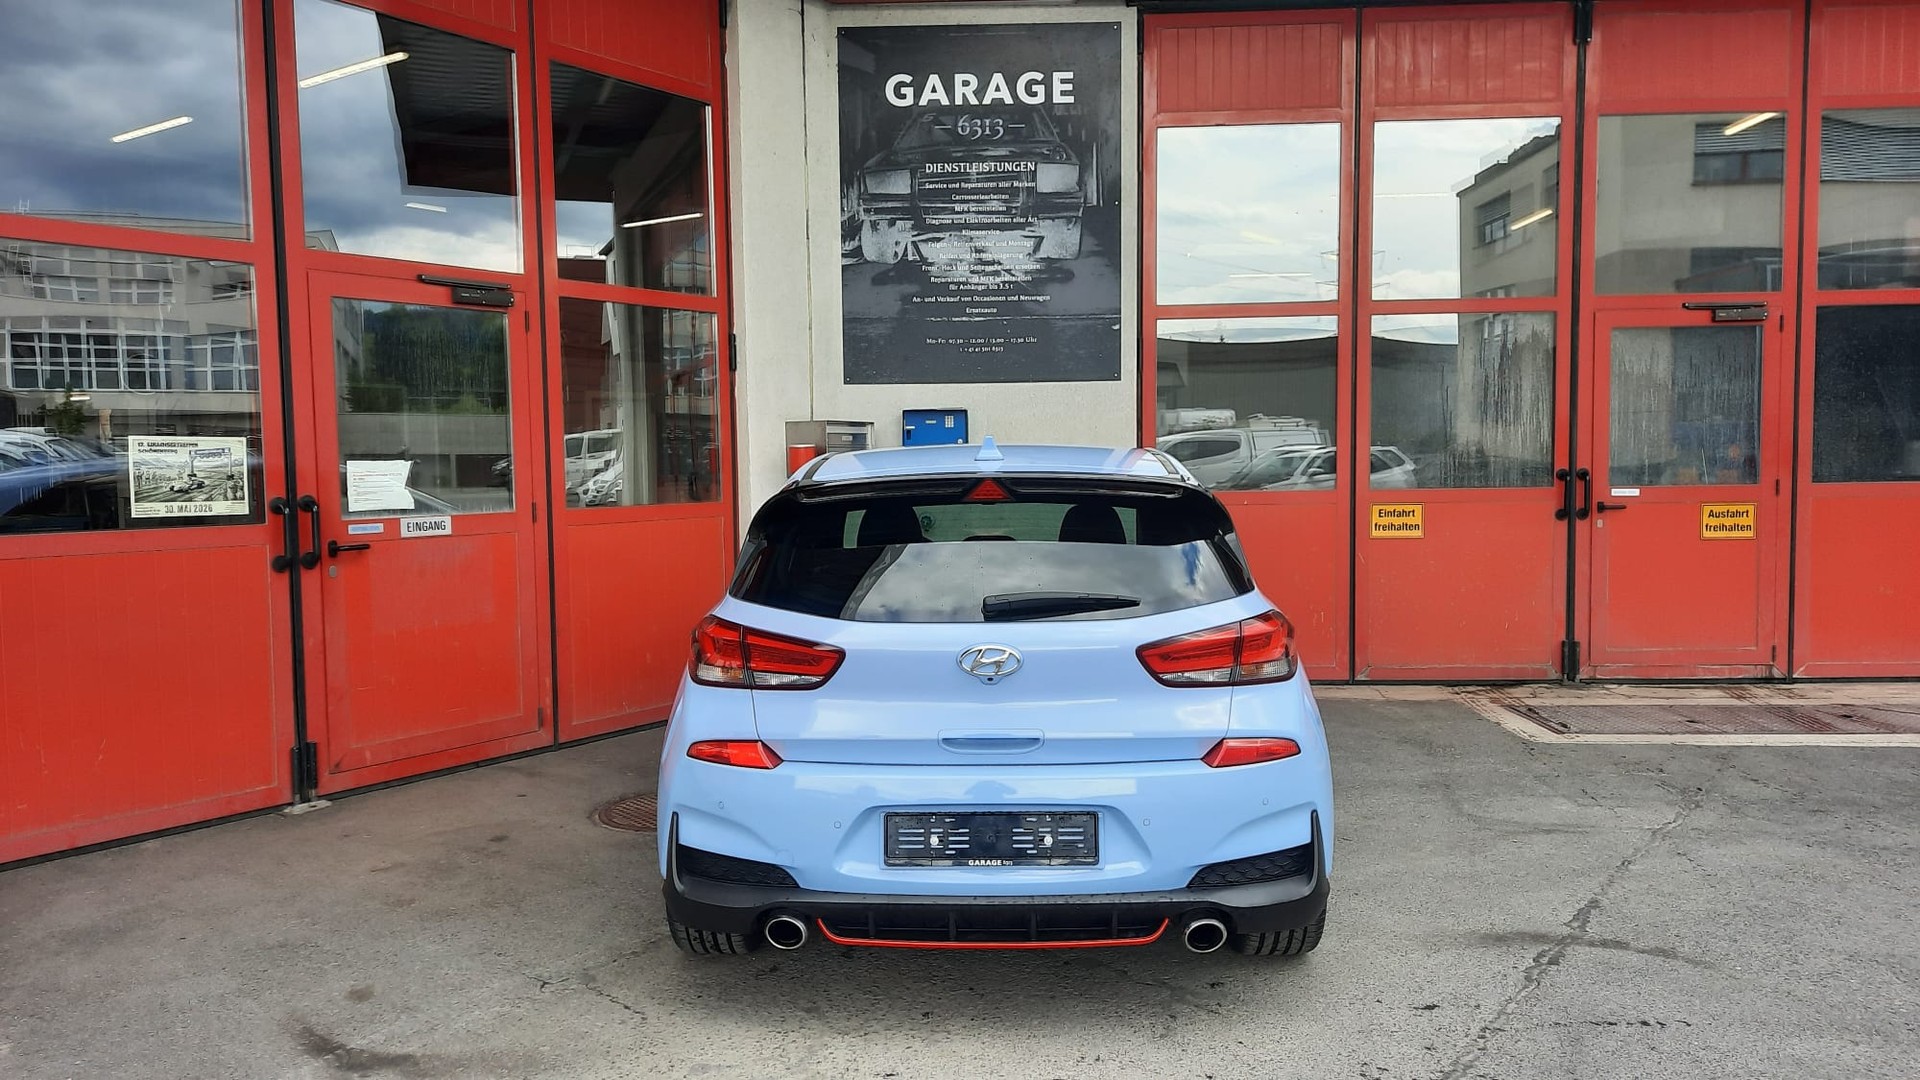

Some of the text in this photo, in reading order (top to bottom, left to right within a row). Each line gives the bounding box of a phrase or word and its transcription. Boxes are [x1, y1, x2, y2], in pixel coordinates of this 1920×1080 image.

[885, 72, 1075, 106] GARAGE
[957, 114, 1004, 139] 6313
[925, 162, 1036, 173] DIENSTLEISTUNGEN
[961, 182, 997, 190] Reparaturen
[177, 504, 192, 514] MAI
[194, 504, 213, 513] 2026
[1378, 508, 1415, 518] Einfahrt
[1708, 509, 1749, 518] Ausfahrt
[406, 520, 446, 532] EINGANG
[1374, 522, 1420, 531] freihalten
[1705, 522, 1752, 532] freihalten
